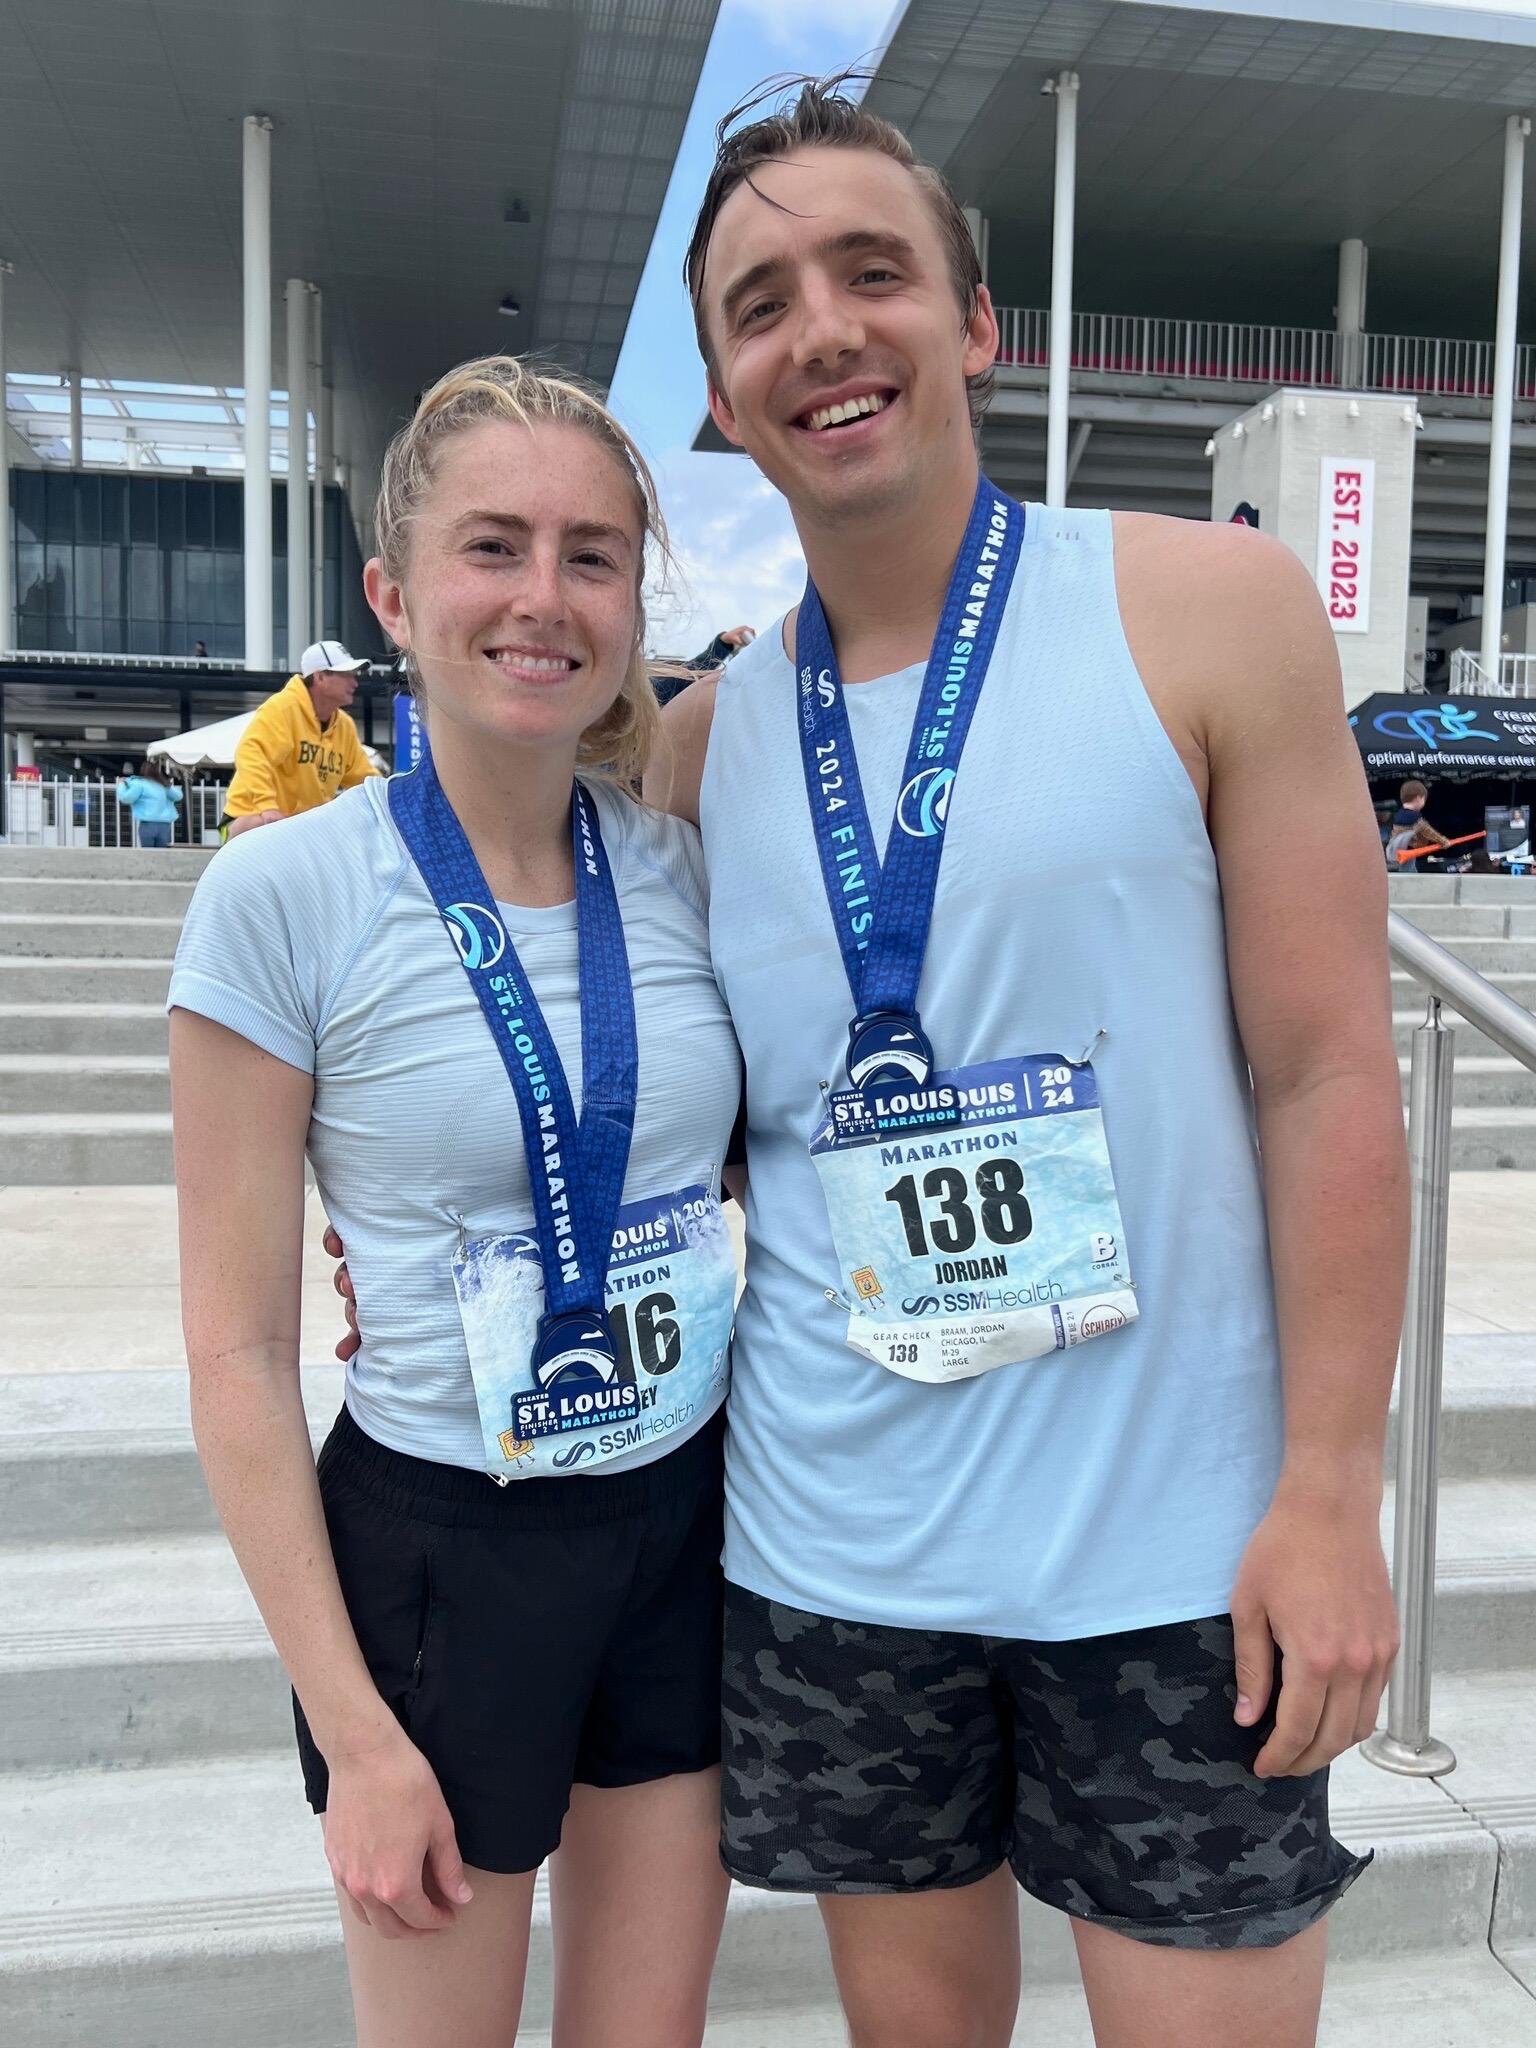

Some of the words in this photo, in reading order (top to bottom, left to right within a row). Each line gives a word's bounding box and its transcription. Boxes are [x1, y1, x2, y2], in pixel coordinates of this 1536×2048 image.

[1333, 471, 1362, 531] EST.
[957, 500, 1008, 638] MARATHON
[1329, 541, 1359, 621] 2023
[936, 640, 973, 716] LOUIS
[926, 720, 952, 758] ST.
[1367, 751, 1415, 767] optimal
[1418, 751, 1496, 767] performance
[1498, 753, 1536, 766] center
[816, 739, 848, 813] 2024
[831, 824, 873, 949] FINIS
[1039, 1066, 1072, 1087] 20
[834, 1101, 872, 1121] ST.
[875, 1088, 954, 1116] LOUIS
[1042, 1087, 1075, 1109] 24
[489, 975, 516, 1016] ST.
[506, 1017, 551, 1101] LOUIS
[537, 1103, 581, 1284] MARATHON
[837, 1118, 875, 1128] FINISHER
[878, 1110, 956, 1129] MARATHON
[880, 1131, 1018, 1167] MARATHON
[885, 1158, 1033, 1257] 138
[611, 1218, 667, 1249] OUIS
[1089, 1231, 1117, 1263] B
[609, 1239, 670, 1264] ARATHON
[1091, 1261, 1119, 1270] CORRAL
[603, 1265, 671, 1295] ATHON
[935, 1255, 1009, 1285] JORDAN
[943, 1279, 1064, 1313] SSMHealth
[873, 1332, 899, 1341] GEAR
[902, 1331, 931, 1341] CHECK
[940, 1328, 969, 1337] BRAAM,
[970, 1322, 1005, 1334] JORDAN
[941, 1337, 978, 1347] CHICAGO,
[979, 1336, 987, 1344] IL
[887, 1343, 919, 1363] 138
[941, 1348, 960, 1357] M-29
[942, 1357, 969, 1367] LARGE
[518, 1402, 556, 1424] ST.
[560, 1385, 636, 1416] LOUIS
[520, 1418, 559, 1431] FINISHER
[561, 1406, 636, 1429] MARATHON
[599, 1401, 695, 1454] SSMHealth
